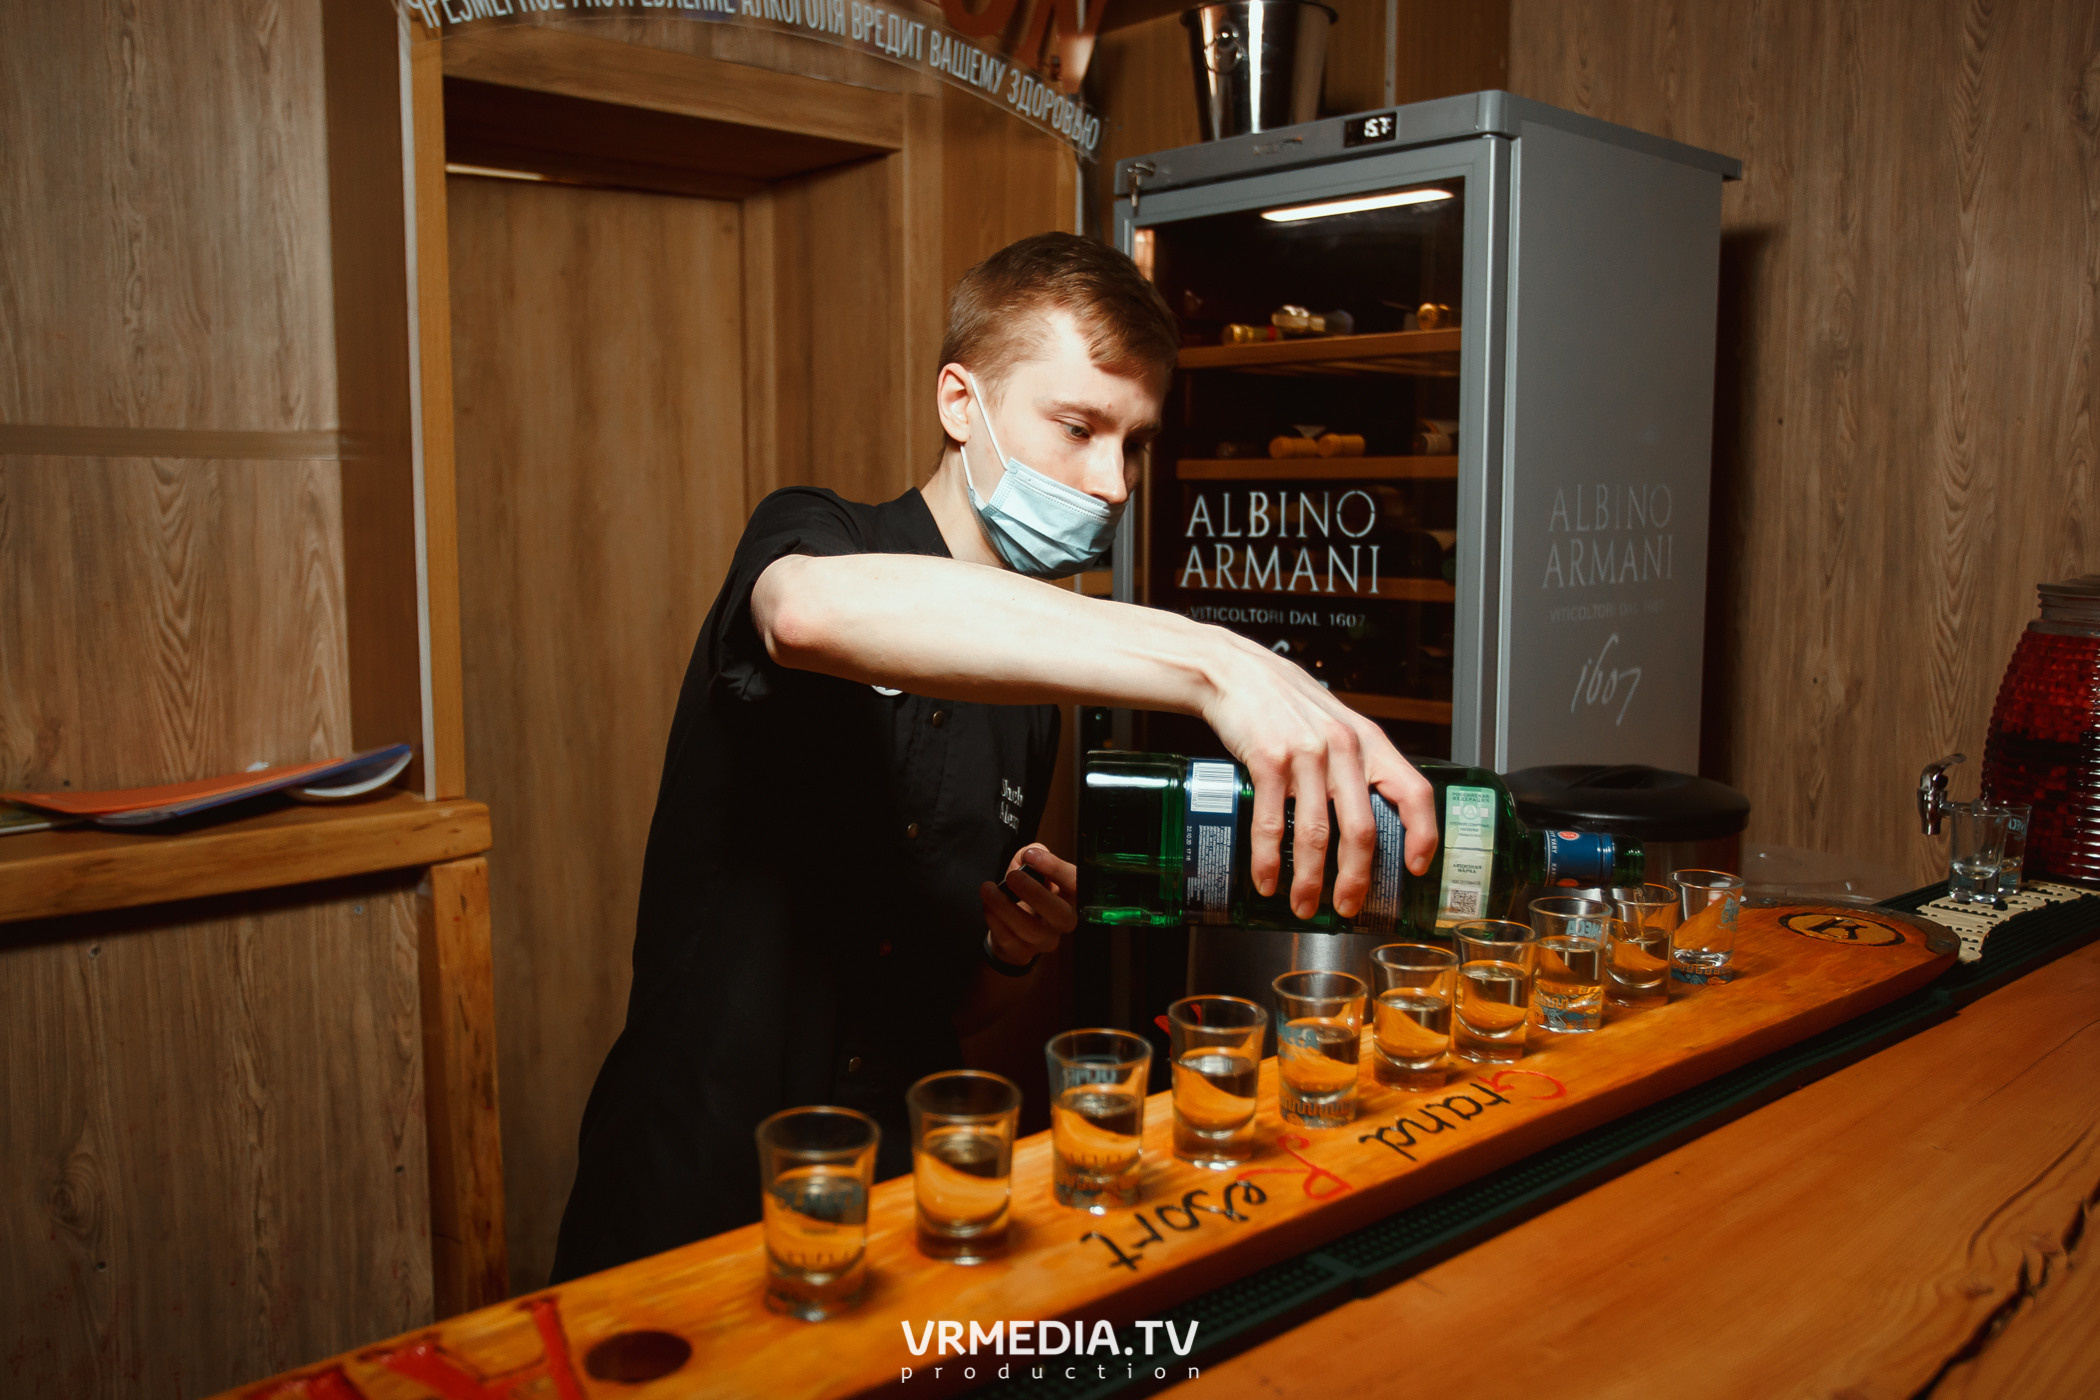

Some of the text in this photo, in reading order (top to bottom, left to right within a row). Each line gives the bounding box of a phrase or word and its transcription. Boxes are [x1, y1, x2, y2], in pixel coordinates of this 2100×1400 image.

[851, 4, 926, 60] ВРЕДИТ
[930, 30, 1006, 95] ВАШЕМУ
[1006, 69, 1101, 150] ЗДОРОВЬЮ
[1185, 490, 1376, 538] ALBINO
[1549, 483, 1672, 532] ALBINO
[1179, 543, 1381, 594] ARMANI
[1541, 534, 1673, 589] ARMANI
[1190, 606, 1366, 628] VITICOLTORI DAL 1607
[1358, 1069, 1567, 1162] Grand
